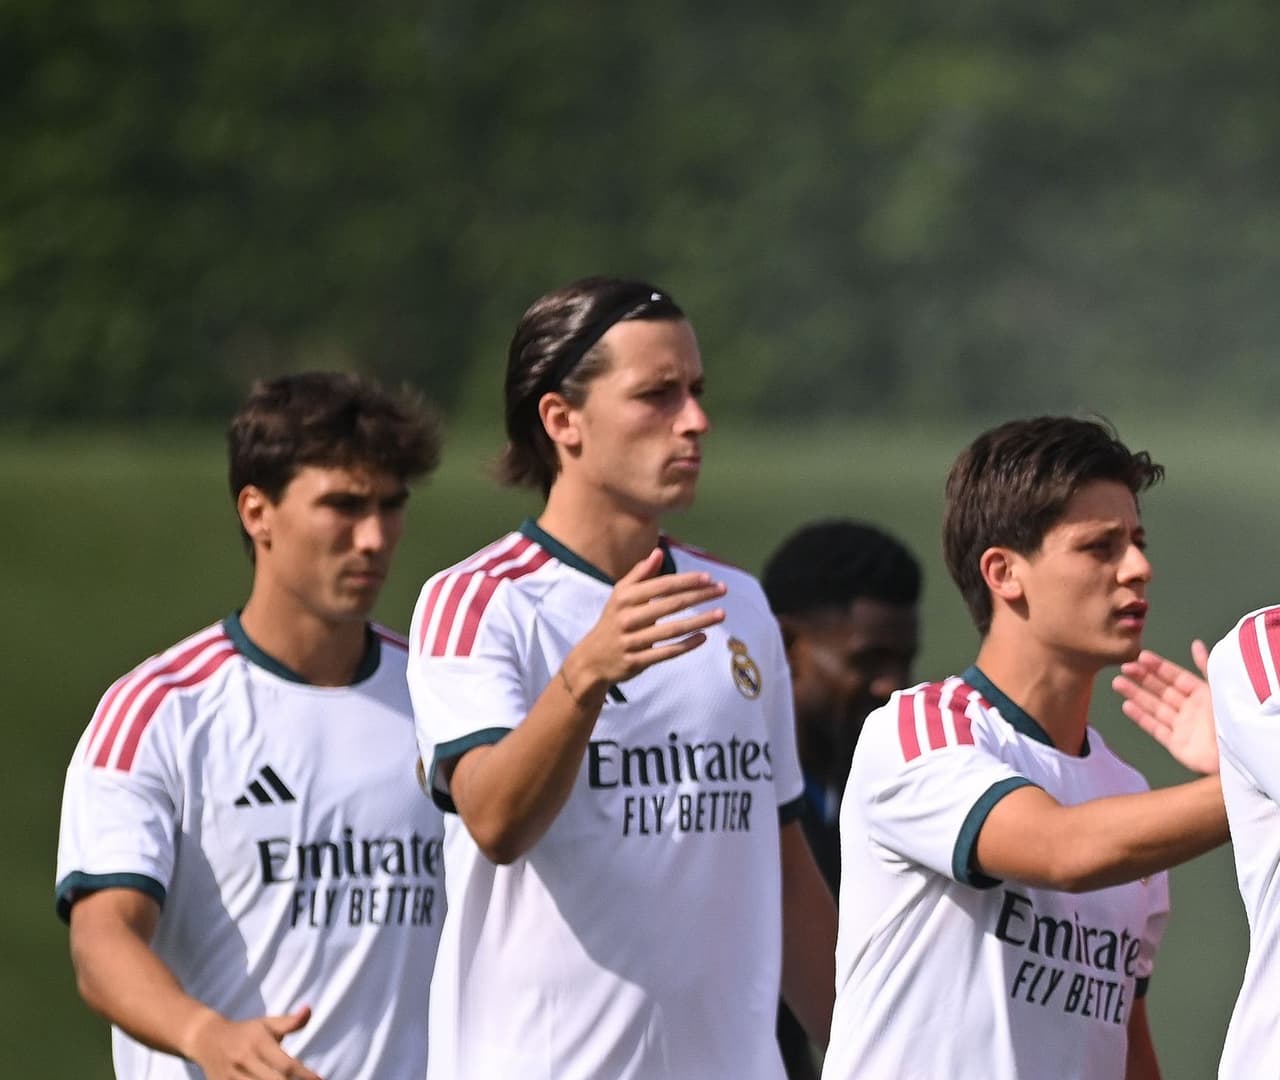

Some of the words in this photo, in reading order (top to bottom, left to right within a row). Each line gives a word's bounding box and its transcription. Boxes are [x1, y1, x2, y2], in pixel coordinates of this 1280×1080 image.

[623, 796, 664, 836] FLY
[679, 792, 752, 832] BETTER
[257, 828, 443, 885] Emirate
[291, 888, 337, 928] FLY
[350, 885, 434, 926] BETTER
[994, 889, 1141, 977] Emirate
[1011, 960, 1064, 1006] FLY
[1063, 973, 1127, 1024] BETTE
